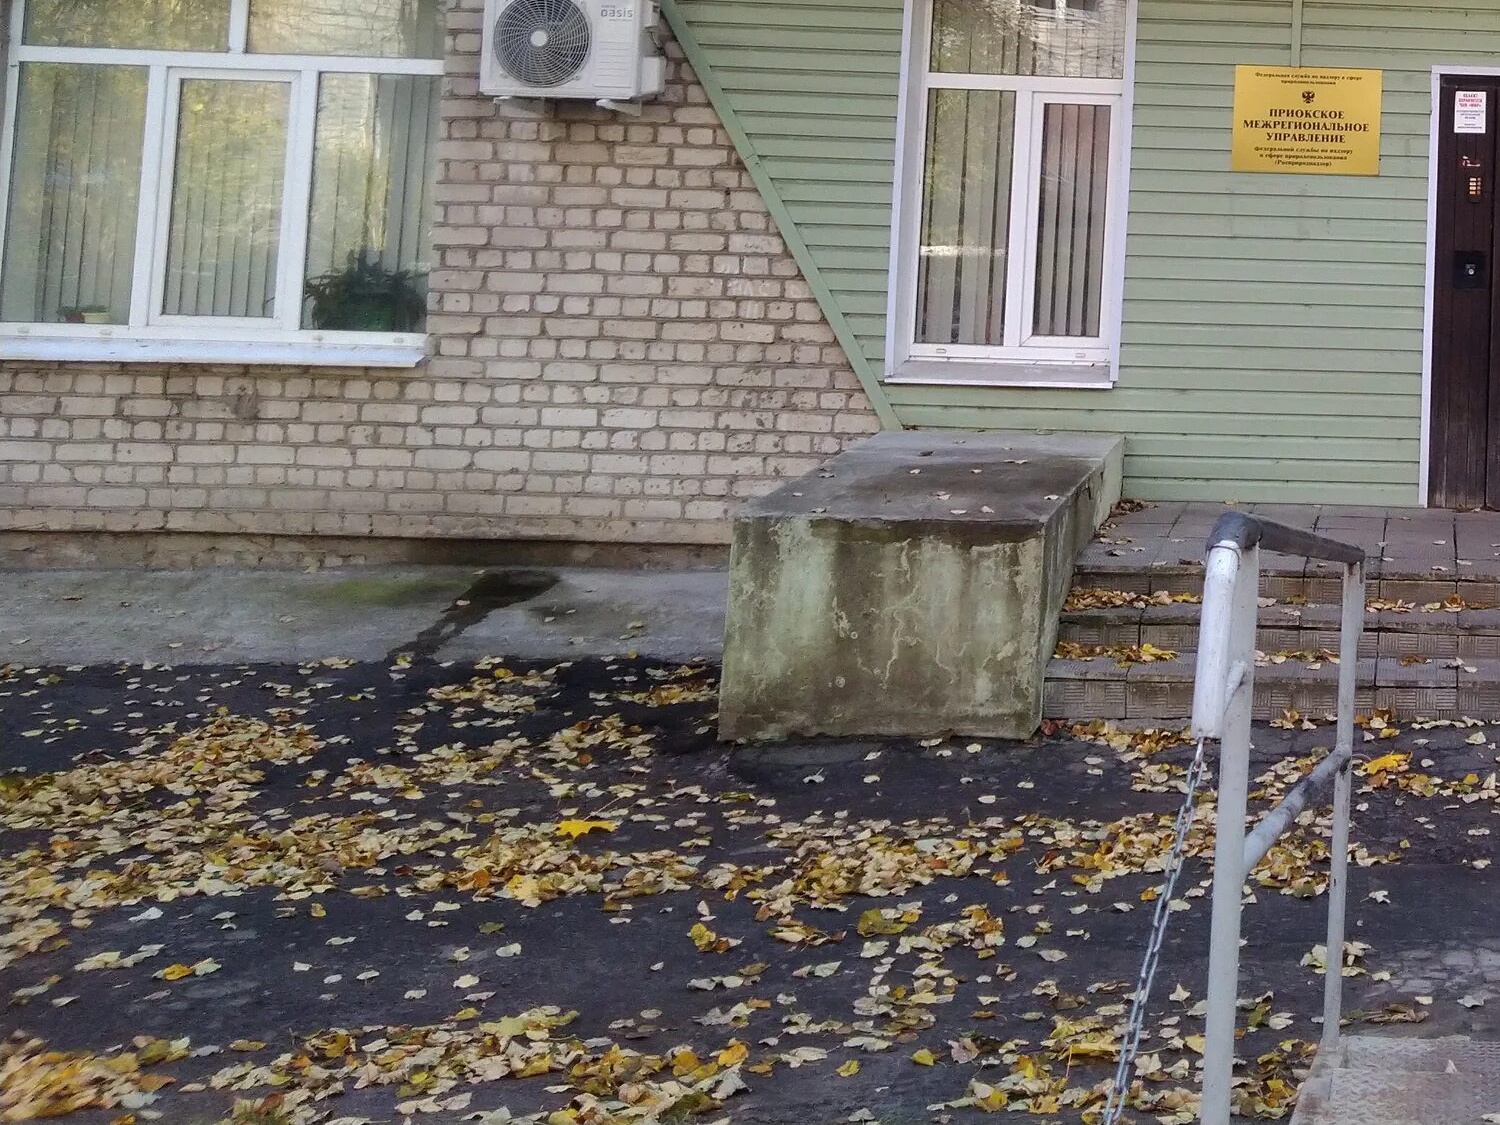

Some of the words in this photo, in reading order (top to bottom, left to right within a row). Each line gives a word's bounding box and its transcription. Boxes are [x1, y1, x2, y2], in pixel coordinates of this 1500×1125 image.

[600, 8, 632, 18] oasis
[1269, 108, 1344, 120] ПРИОКСКОЕ
[1243, 120, 1369, 132] МЕЖРЕГИОНАЛЬНОЕ
[1266, 132, 1345, 143] УПРАВЛЕНИЕ
